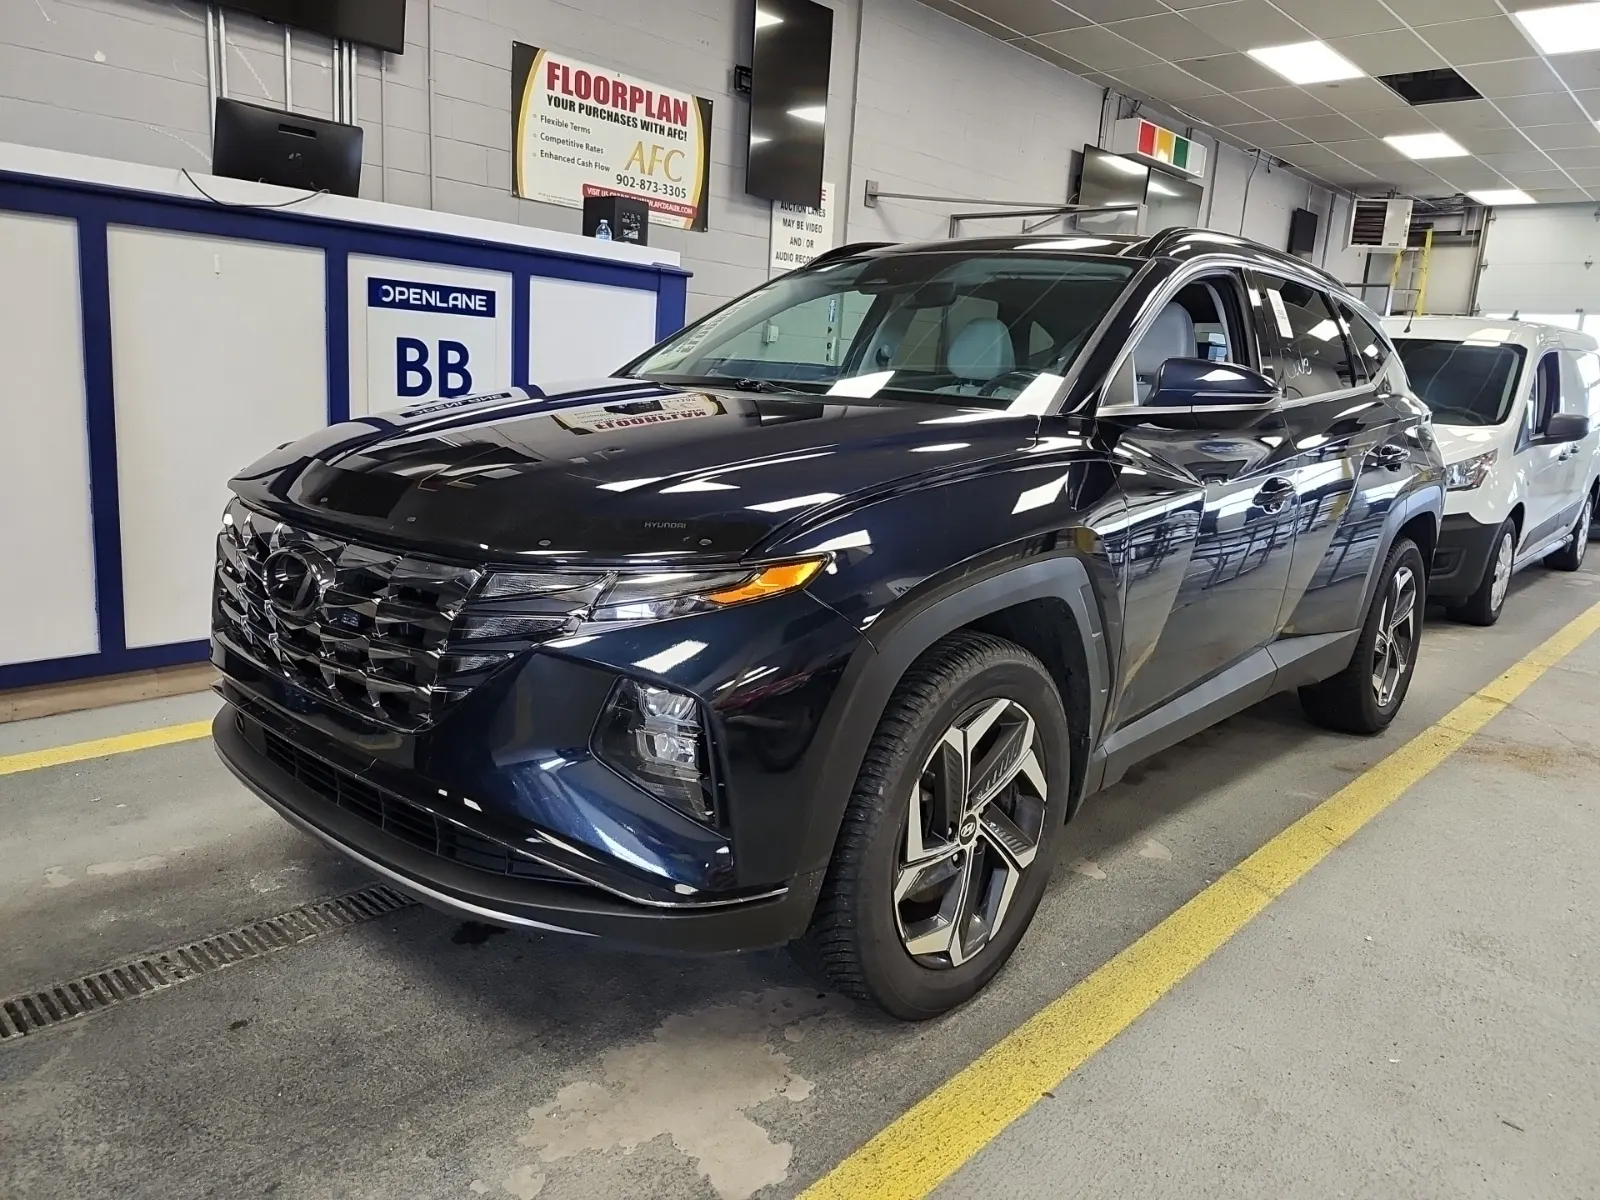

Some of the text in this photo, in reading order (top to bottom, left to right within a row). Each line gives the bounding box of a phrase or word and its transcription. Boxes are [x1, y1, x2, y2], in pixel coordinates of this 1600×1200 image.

[547, 61, 688, 127] FLOORPLAN
[540, 115, 591, 135] Flexible Terms
[547, 94, 688, 142] YOUR PURCHASES WITH AFC!
[540, 132, 604, 155] Competitive Rates
[540, 150, 611, 173] Enhanced Cash Flow
[624, 140, 686, 183] AFC
[587, 186, 601, 196] VISIT
[616, 173, 687, 199] 902-873-3305
[780, 201, 807, 214] AUCTION
[782, 218, 823, 234] MAY BE VIDEO
[789, 236, 802, 247] AND
[806, 239, 814, 248] OR
[775, 251, 794, 263] AUDIO
[380, 284, 488, 312] OPENLANE
[396, 336, 473, 399] BB
[644, 521, 687, 529] HYUNDAI
